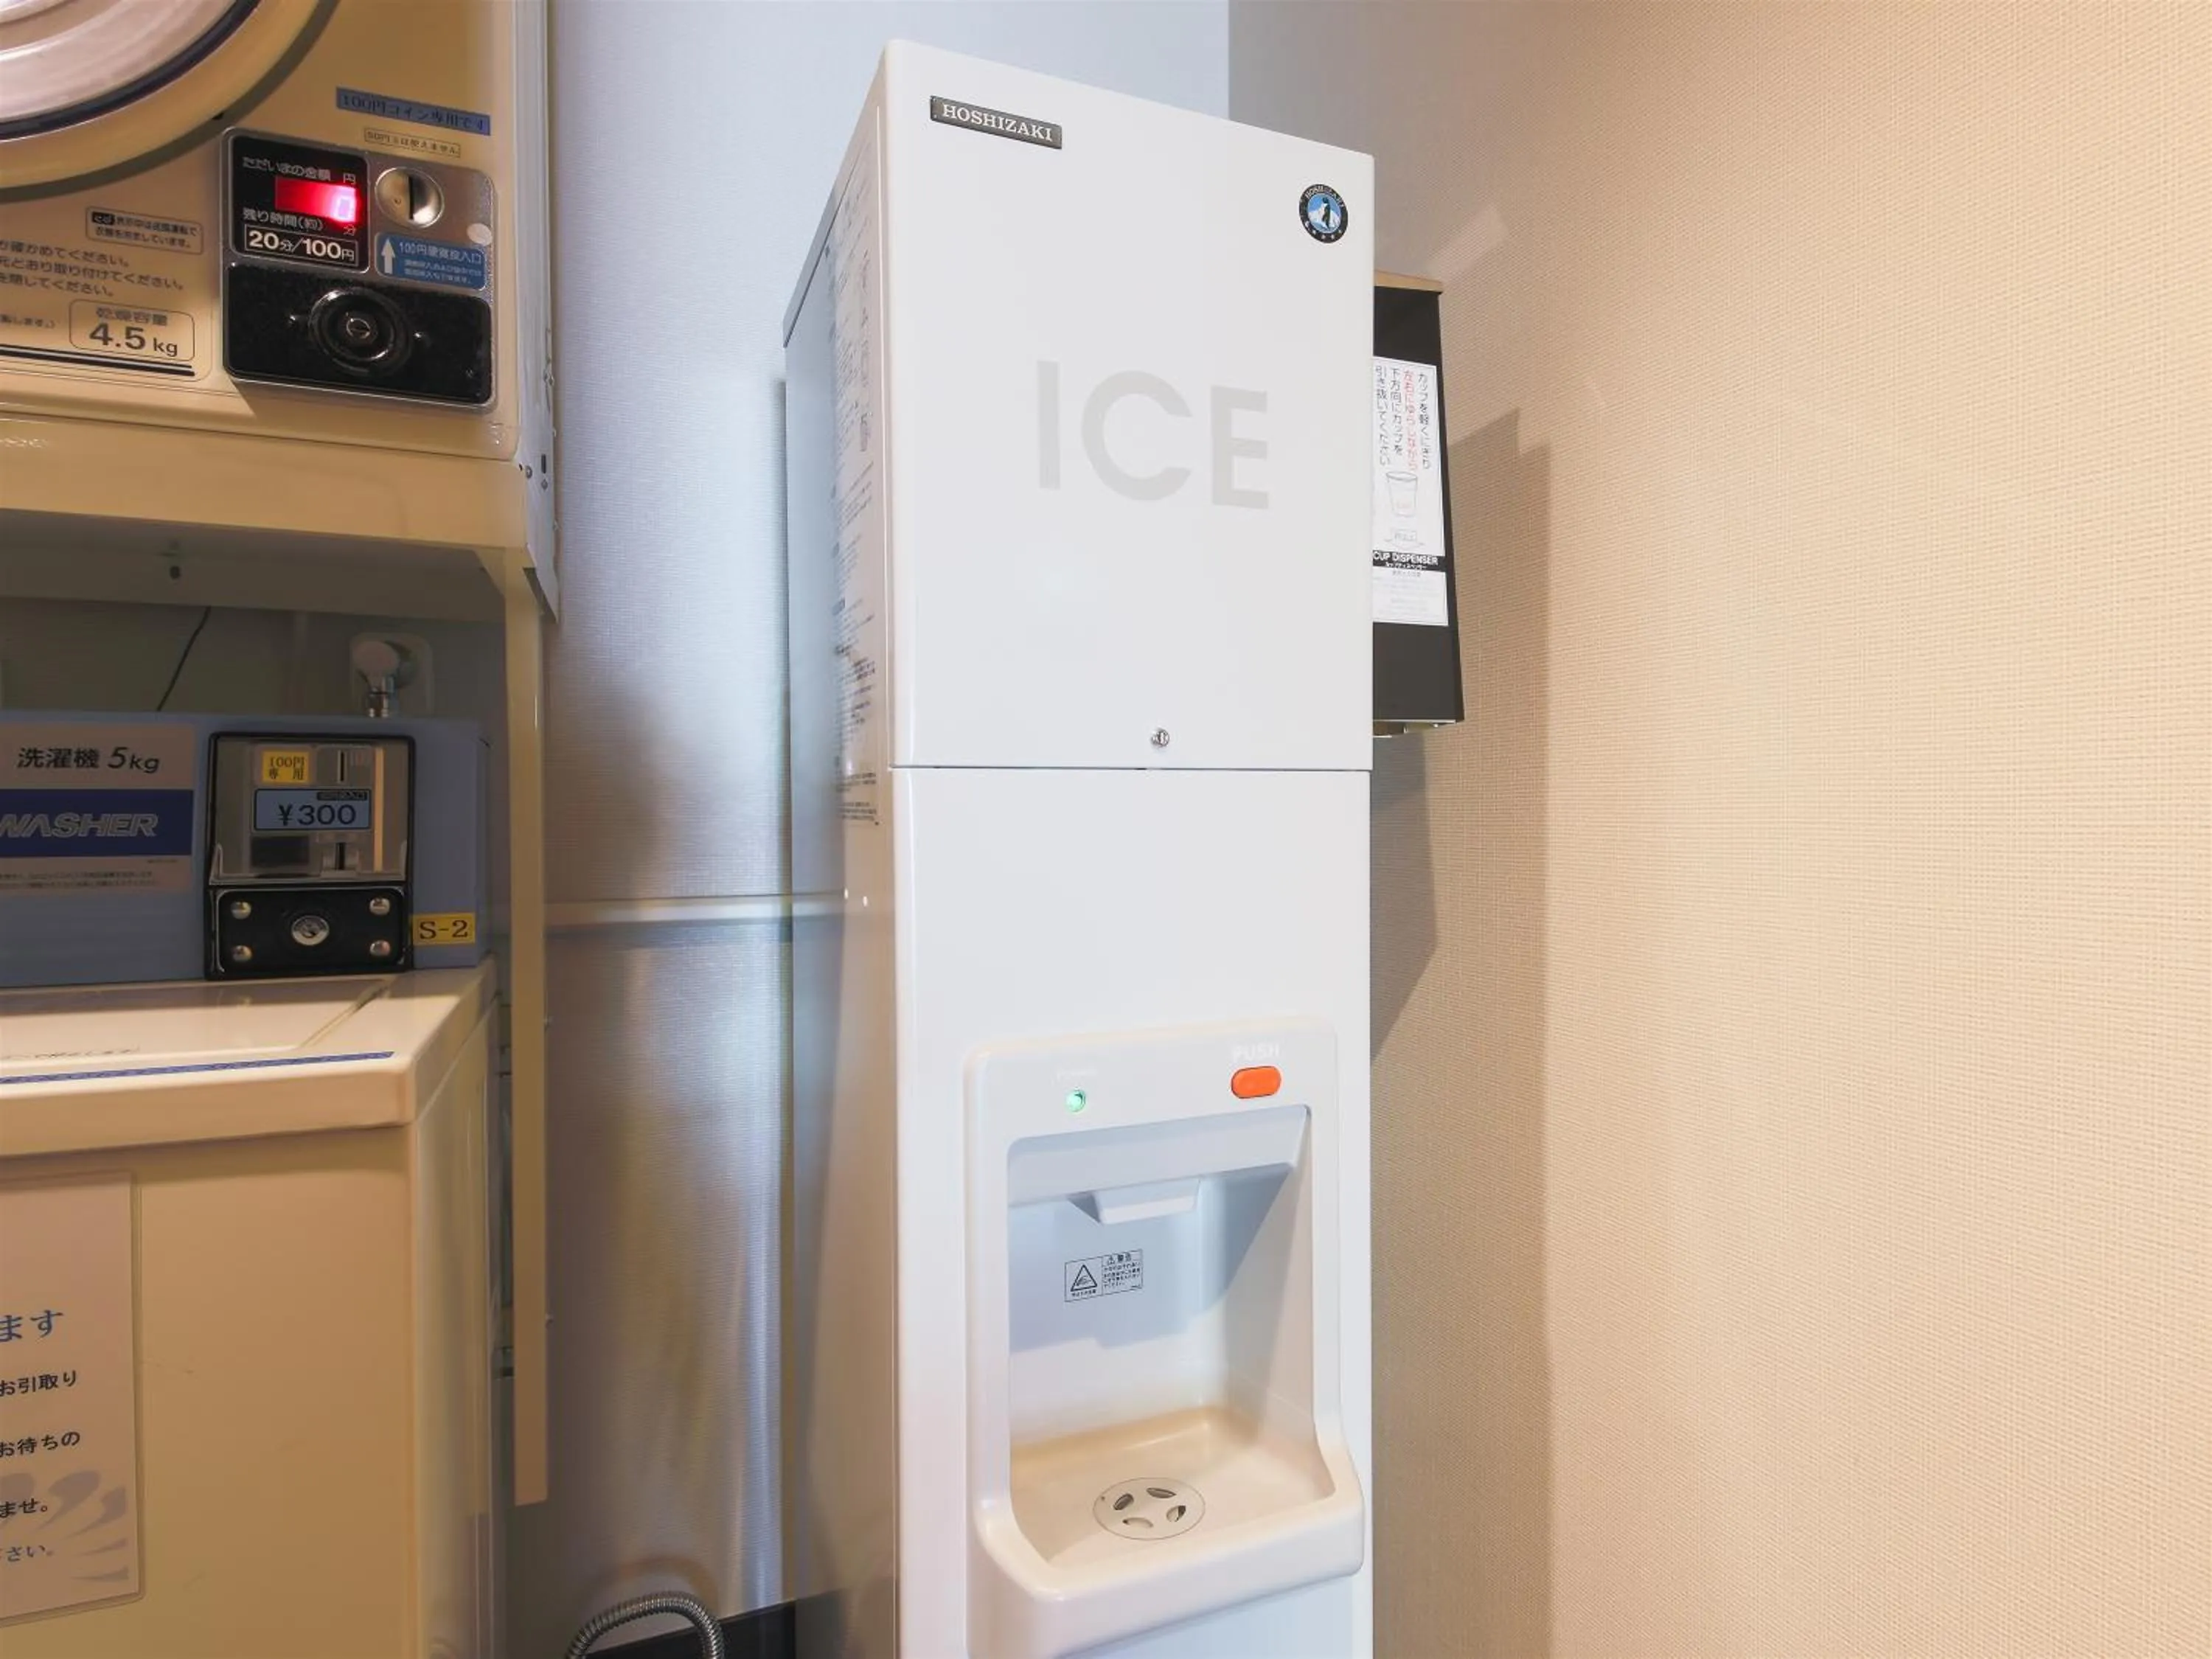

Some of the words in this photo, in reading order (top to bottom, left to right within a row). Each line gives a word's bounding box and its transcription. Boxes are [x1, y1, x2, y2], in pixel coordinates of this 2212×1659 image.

[942, 103, 1054, 142] HOSHIZAKI
[343, 173, 356, 185] 円
[343, 224, 356, 236] 分
[248, 230, 355, 261] 20分/100円
[89, 322, 146, 350] 4.5
[153, 338, 178, 358] kg
[1037, 359, 1270, 509] ICE
[1373, 552, 1391, 561] CUP
[1392, 552, 1439, 566] DISPENSER
[18, 747, 100, 769] 洗濯機
[108, 746, 160, 773] 5kg
[268, 756, 305, 768] 100円
[0, 813, 159, 838] WASHER
[278, 804, 357, 827] ¥300
[419, 919, 469, 940] S-2
[0, 1310, 63, 1343] ます
[0, 1370, 77, 1397] お引取り
[0, 1430, 80, 1458] お待ちの
[0, 1498, 48, 1518] ませ。
[0, 1545, 54, 1563] さい。
